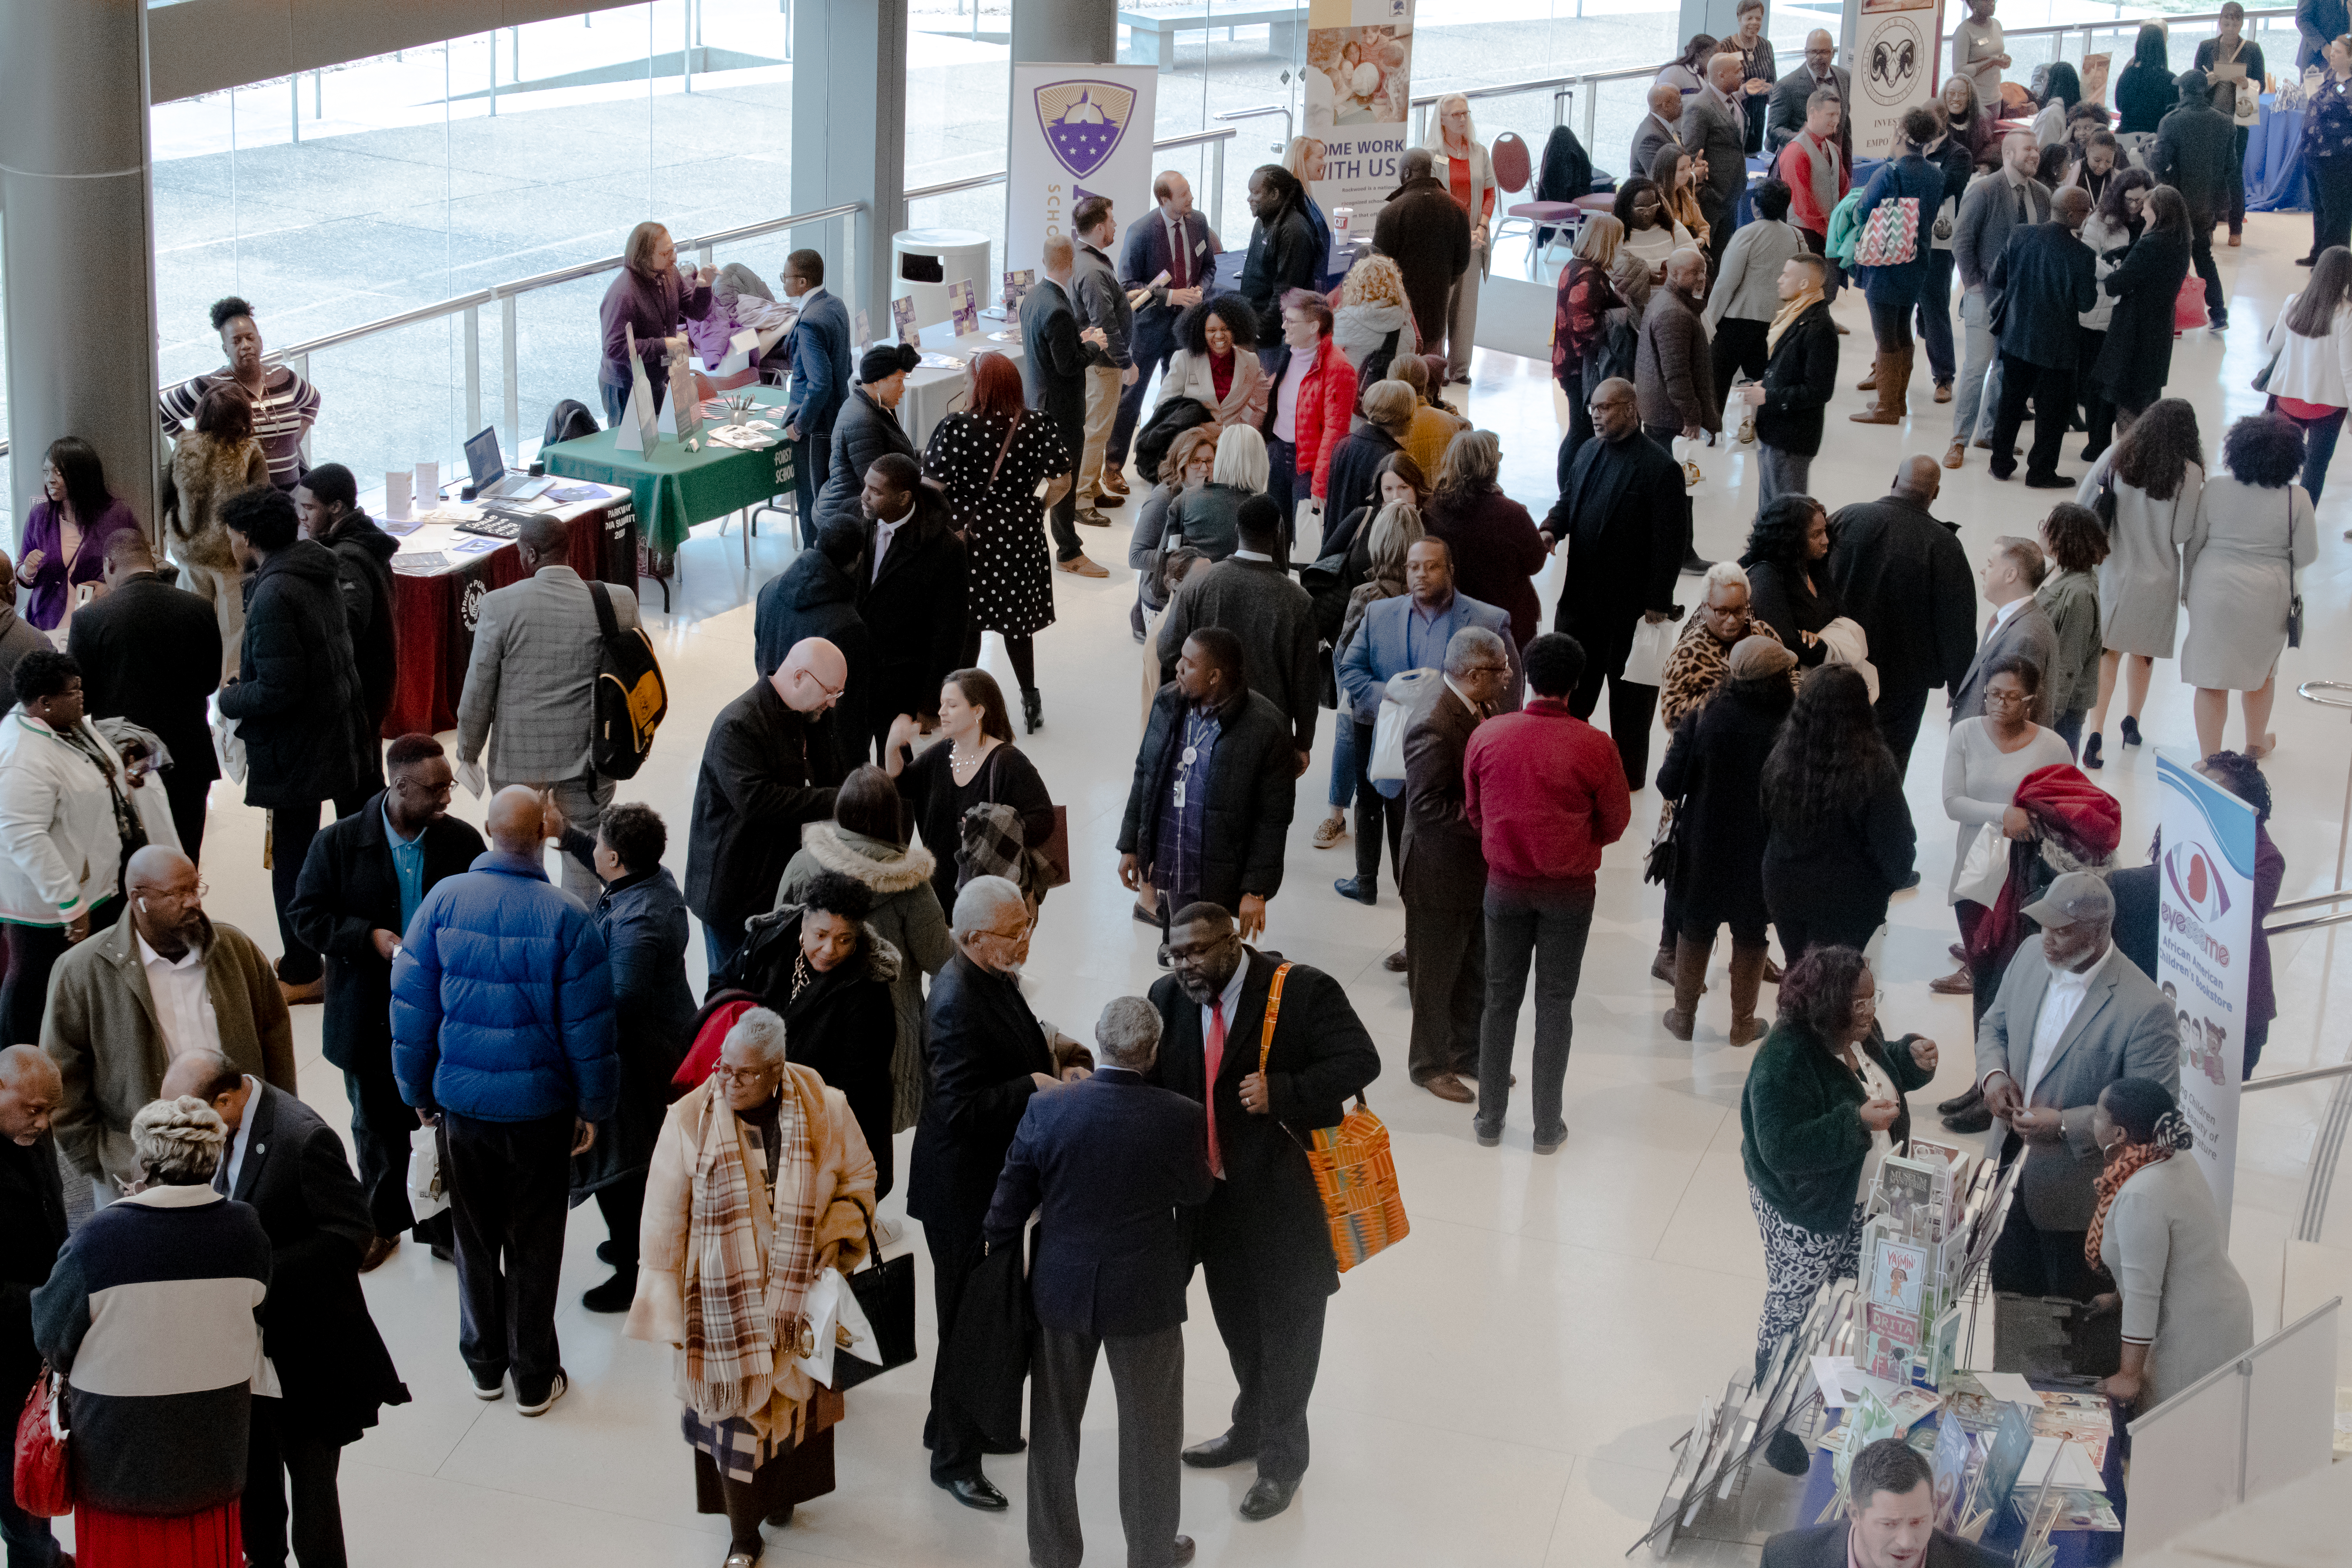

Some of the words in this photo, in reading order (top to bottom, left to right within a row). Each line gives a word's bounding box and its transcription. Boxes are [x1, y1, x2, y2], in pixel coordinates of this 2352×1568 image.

[1357, 139, 1404, 154] WORK
[1369, 158, 1396, 177] US
[1334, 217, 1346, 228] QT
[608, 503, 632, 518] PARKWAY
[615, 514, 635, 528] SUMMIT
[614, 528, 625, 539] 2020
[2163, 935, 2191, 962] African
[2192, 956, 2223, 991] American
[2159, 947, 2195, 982] Children's
[2196, 974, 2233, 1013] Bookstore
[2189, 1093, 2215, 1125] Children
[2187, 1107, 2207, 1137] Beauty
[2209, 1132, 2219, 1143] of
[1873, 1312, 1913, 1336] DRITA
